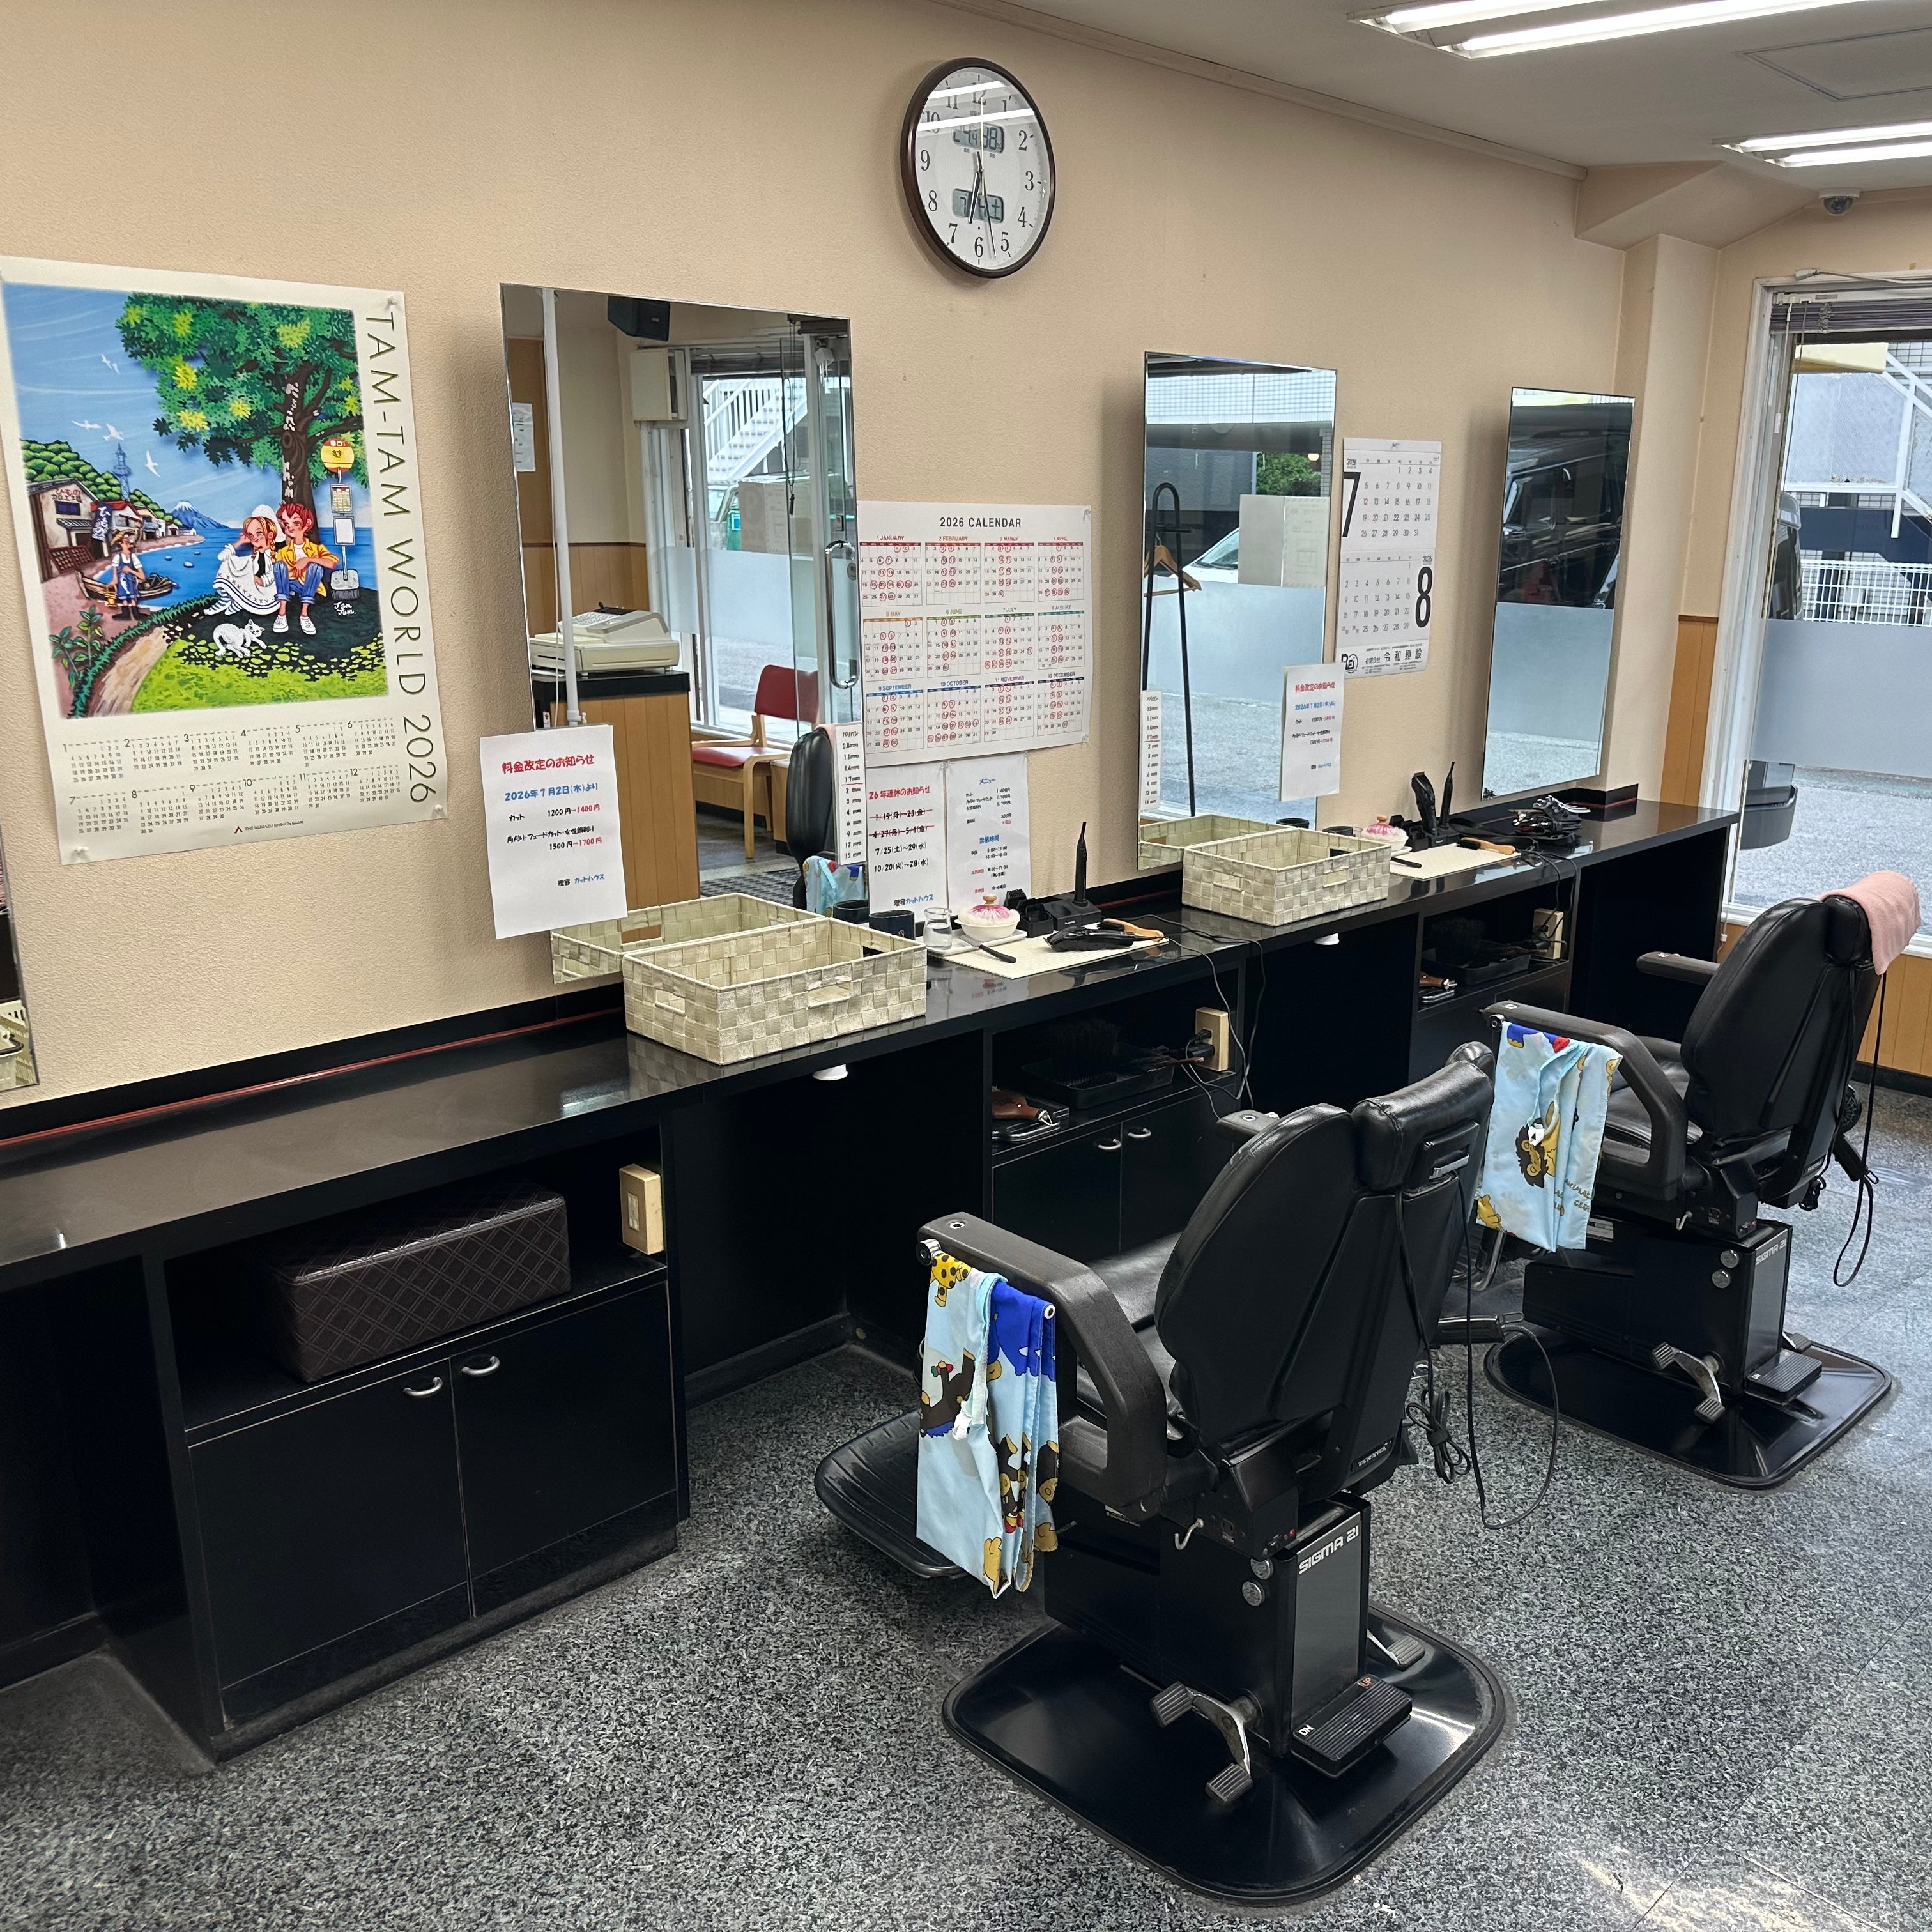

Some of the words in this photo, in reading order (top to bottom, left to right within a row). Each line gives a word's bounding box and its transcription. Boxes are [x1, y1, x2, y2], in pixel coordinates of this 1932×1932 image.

[1019, 130, 1027, 151] 2
[921, 150, 930, 171] 9
[1025, 171, 1034, 191] 3
[928, 190, 938, 211] 8
[1018, 207, 1026, 227] 4
[949, 223, 958, 243] 7
[1001, 232, 1009, 252] 5
[974, 237, 983, 257] 6
[365, 312, 410, 516] TAM-TAM
[1342, 472, 1361, 537] 7
[940, 517, 964, 527] 2026
[969, 518, 1022, 528] CALENDAR
[1415, 566, 1433, 628] 8
[386, 539, 426, 696] WORLD
[63, 744, 67, 752] 1
[124, 739, 130, 747] 2
[403, 714, 436, 804] 2026
[502, 754, 595, 774] 料金改定のお知らせ
[350, 768, 358, 776] 12
[132, 790, 137, 799] 8
[574, 873, 605, 884] カットハウス
[1756, 1245, 1779, 1266] SIGMA
[1298, 1534, 1344, 1575] SIGMA
[1360, 1676, 1372, 1687] UP
[1298, 1724, 1314, 1736] DN
